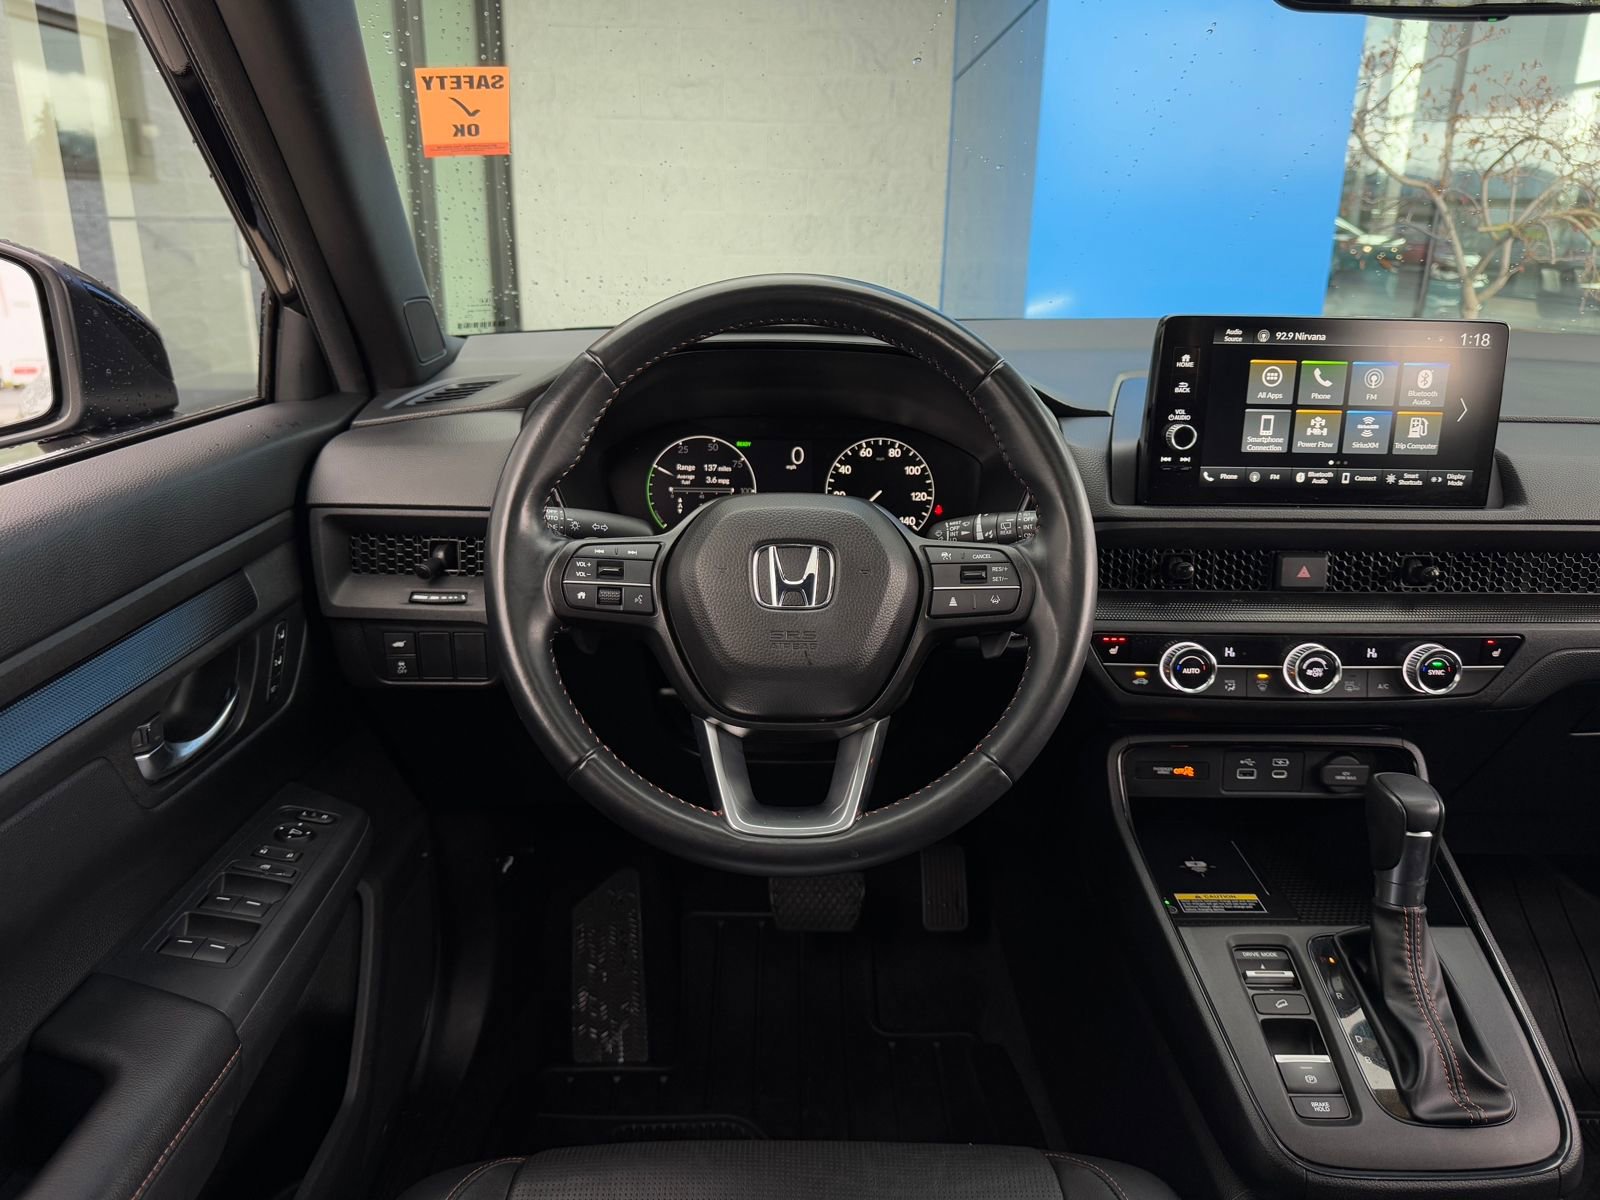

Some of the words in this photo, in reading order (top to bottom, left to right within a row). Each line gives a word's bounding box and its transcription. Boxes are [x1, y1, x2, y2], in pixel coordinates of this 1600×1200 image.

[1225, 328, 1243, 336] Audio
[1275, 331, 1294, 341] 92.9
[1295, 332, 1327, 341] Nirvana
[1460, 333, 1491, 347] 1:18
[1267, 392, 1283, 400] Apps
[1311, 392, 1331, 400] Phone
[1412, 398, 1431, 406] Audio
[1247, 436, 1284, 444] Smartphone
[707, 443, 719, 452] 50
[1247, 444, 1282, 452] Connection
[1317, 441, 1333, 449] Flow
[678, 445, 689, 454] 25
[859, 448, 873, 457] 60
[888, 448, 901, 458] 80
[791, 446, 805, 464] 0
[676, 464, 696, 472] Range
[704, 464, 717, 472] 137
[732, 460, 743, 468] 75
[838, 465, 852, 475] 40
[904, 466, 921, 475] 100
[705, 476, 718, 484] 3.6
[1446, 473, 1466, 481] Display
[911, 492, 928, 501] 120
[770, 631, 817, 640] SRS
[1335, 992, 1344, 1000] R
[1355, 1035, 1363, 1043] D
